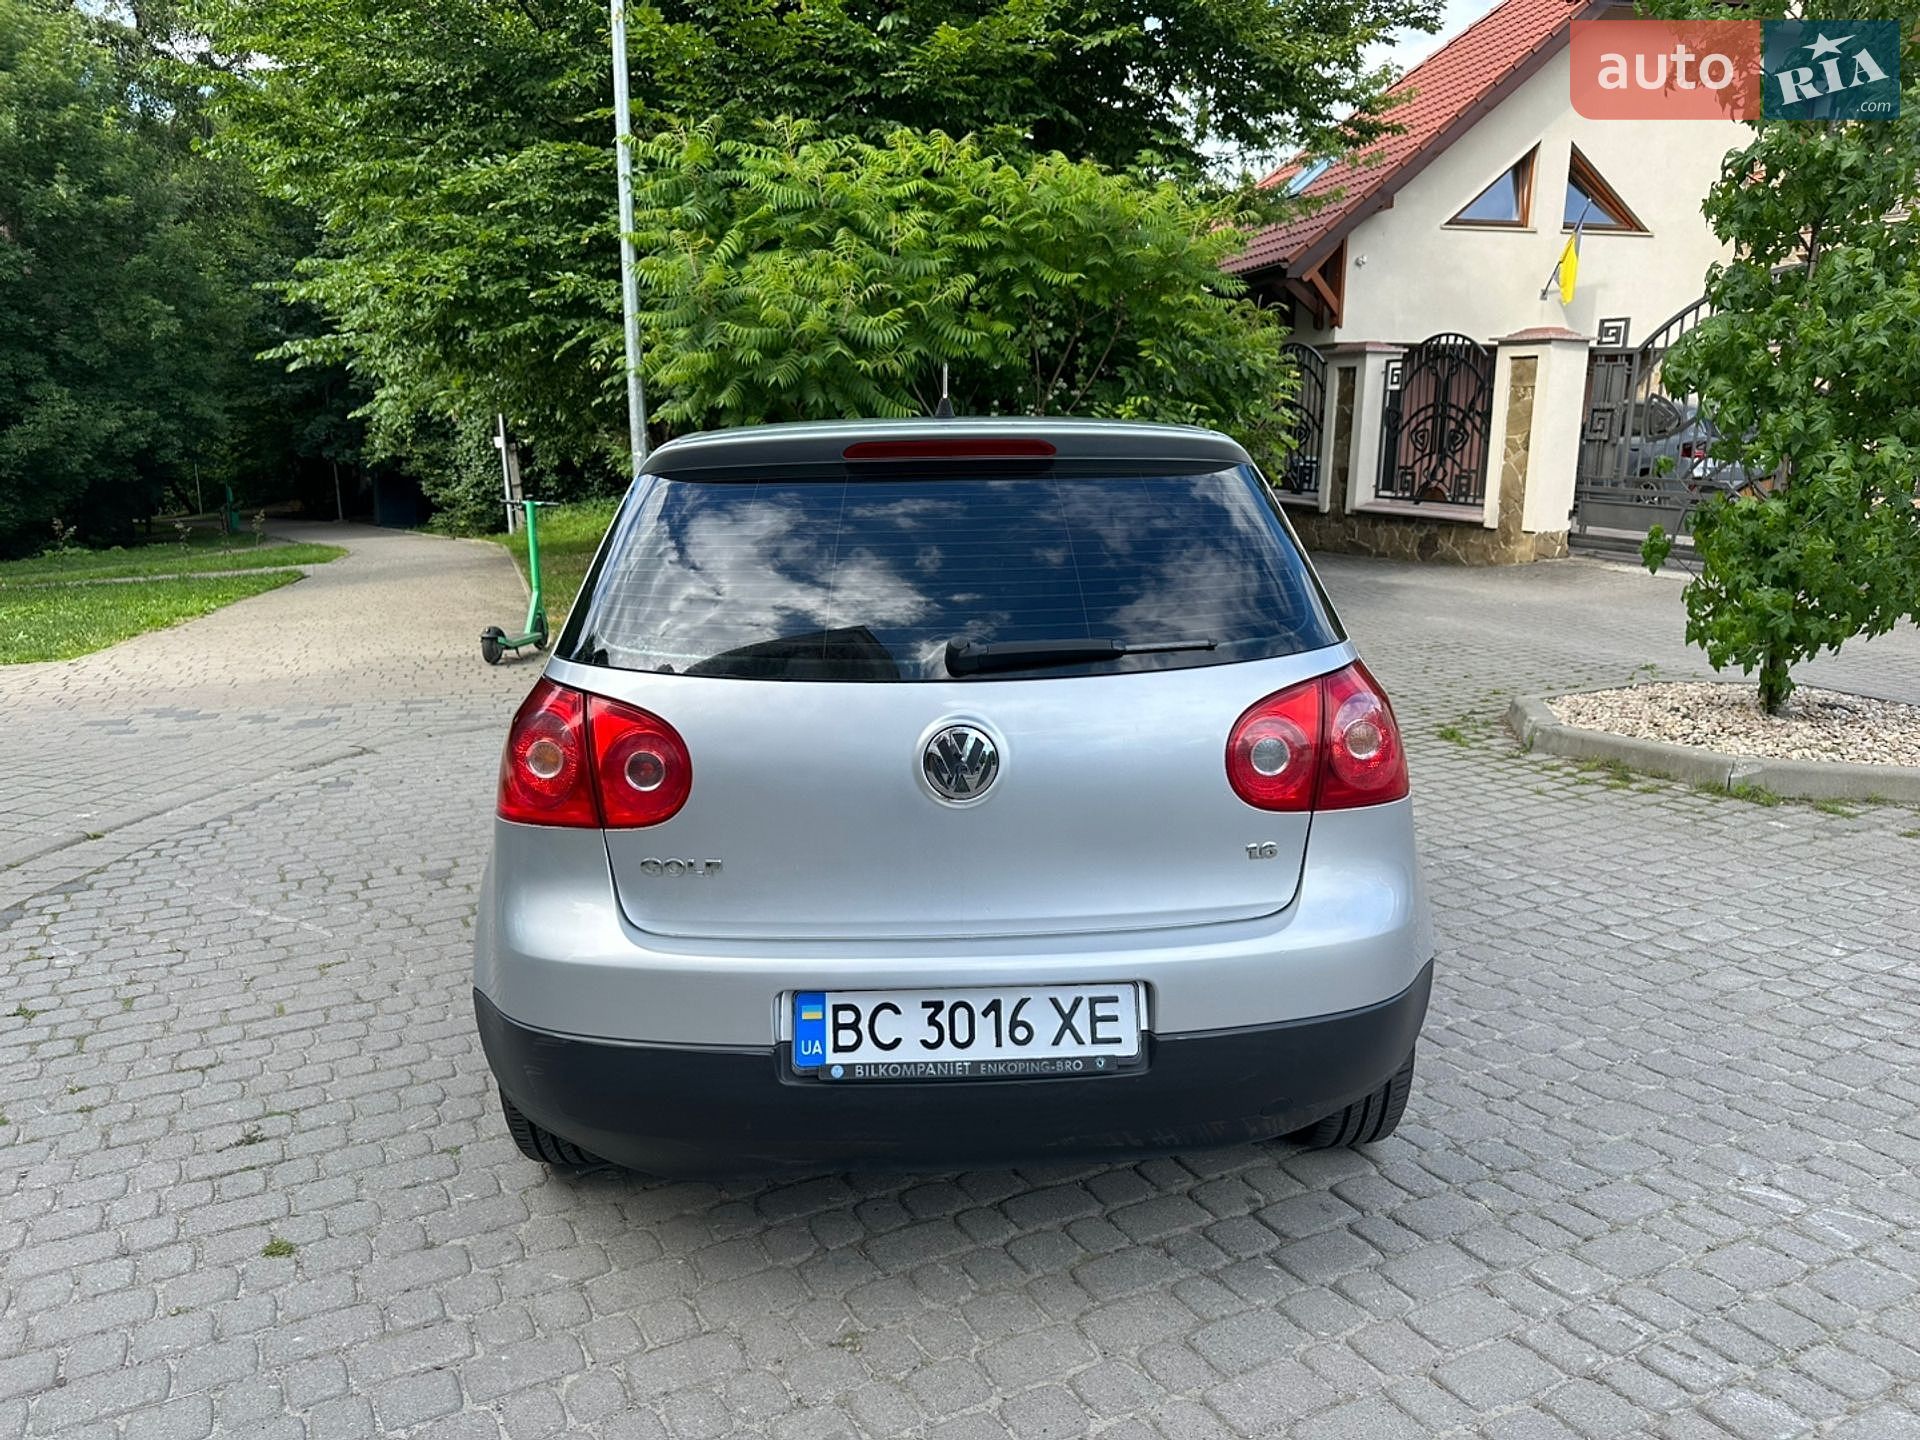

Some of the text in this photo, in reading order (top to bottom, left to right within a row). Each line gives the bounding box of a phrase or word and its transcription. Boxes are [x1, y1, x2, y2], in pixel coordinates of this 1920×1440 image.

[640, 857, 722, 877] GOLF
[832, 995, 1123, 1053] BC 3016 XE
[801, 1041, 823, 1056] UA
[854, 1062, 972, 1078] BILKOMPANIET
